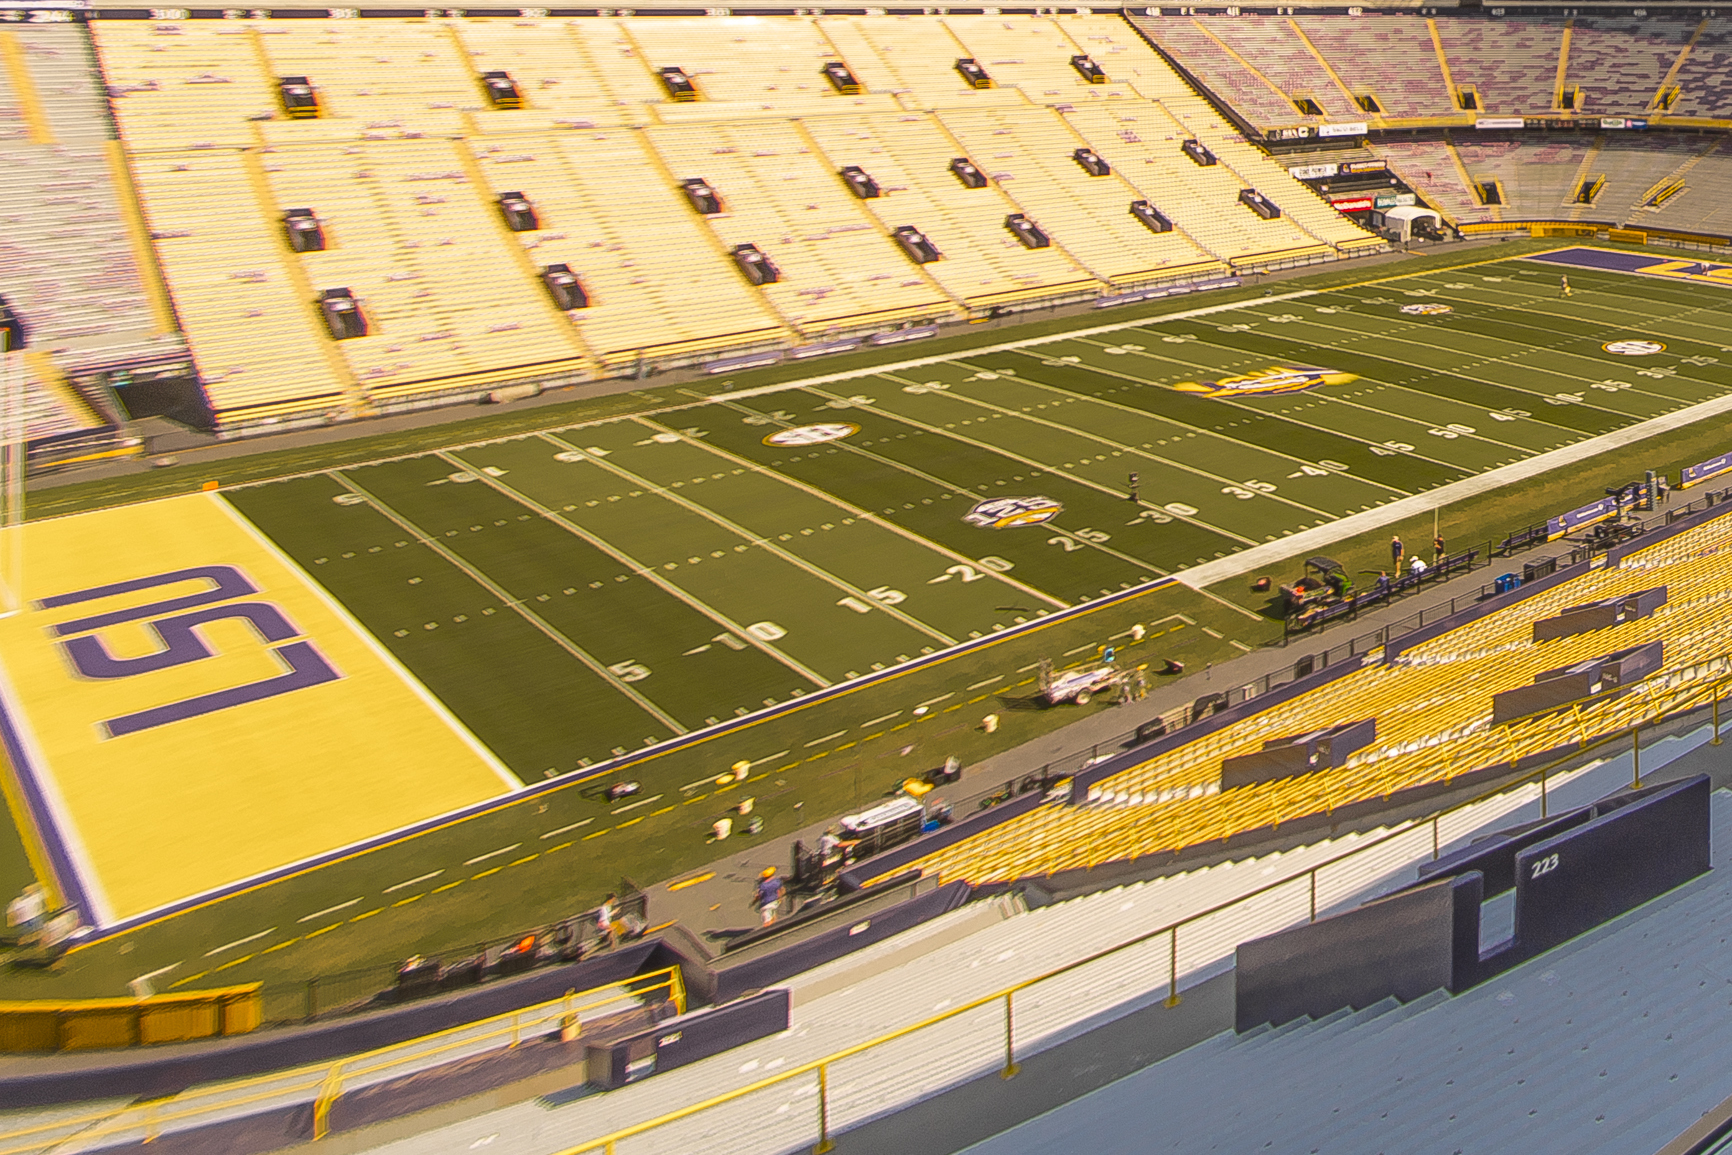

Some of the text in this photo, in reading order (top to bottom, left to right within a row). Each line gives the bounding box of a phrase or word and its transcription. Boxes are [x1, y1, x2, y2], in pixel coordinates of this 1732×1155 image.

[1489, 407, 1532, 422] 45
[1427, 423, 1477, 440] 50
[1368, 440, 1416, 457] 45
[1300, 459, 1349, 477] 40
[1221, 479, 1278, 500] 35
[1138, 502, 1199, 524] 30
[1047, 527, 1112, 552] 25
[945, 556, 1015, 583] 20
[836, 585, 908, 614] 15
[711, 621, 789, 650] 10
[32, 563, 346, 739] LSU
[606, 659, 652, 682] 5
[1531, 852, 1559, 880] 223
